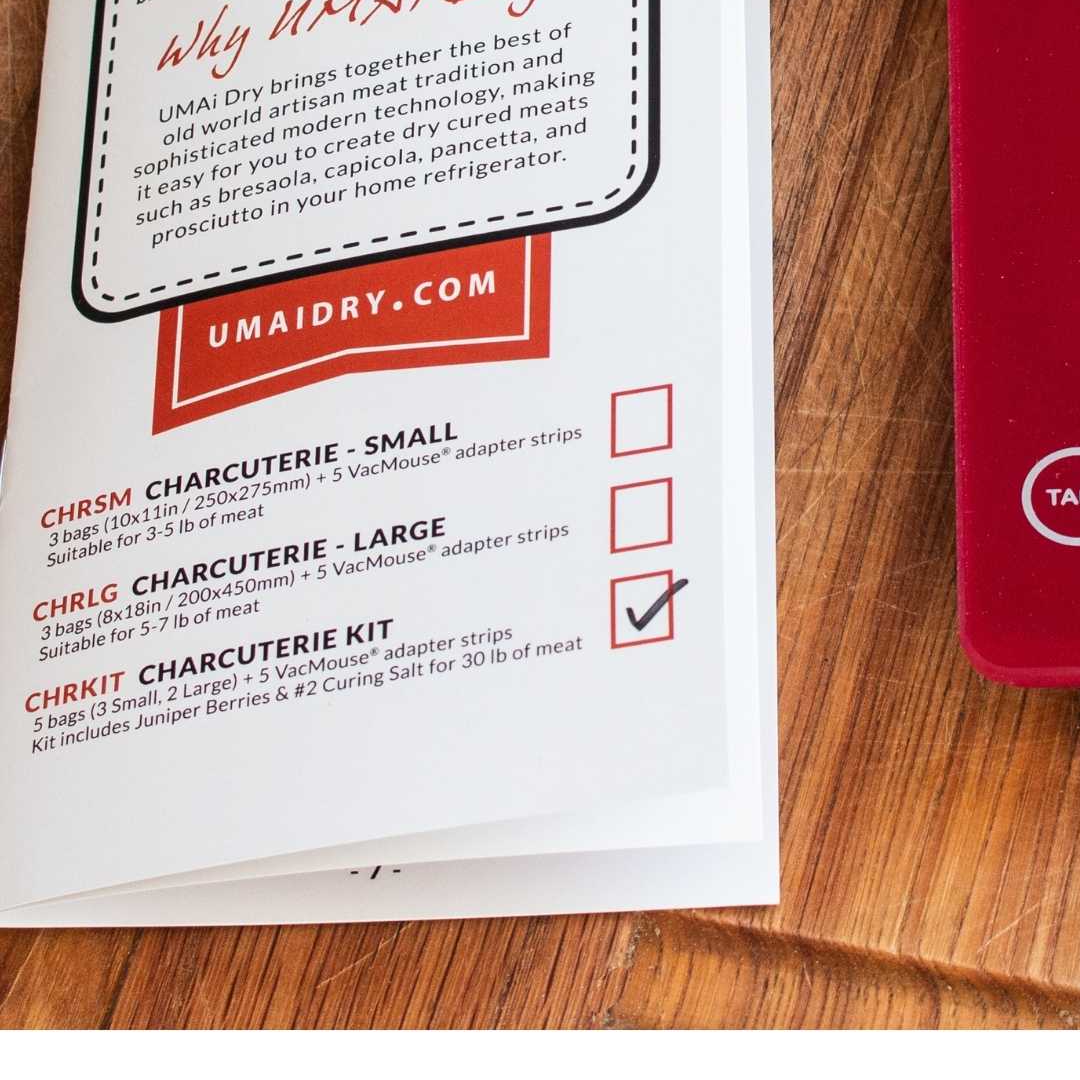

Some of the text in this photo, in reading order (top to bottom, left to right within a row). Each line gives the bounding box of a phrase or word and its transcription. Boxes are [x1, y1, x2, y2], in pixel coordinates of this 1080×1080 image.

[156, 3, 251, 80] Why
[159, 22, 572, 124] UMAi Dry brings together the best of
[132, 71, 596, 179] sophisticated modern technology, making
[137, 95, 589, 202] it easy for you to create dry cured meats
[162, 47, 563, 146] old world artisan meat tradition and
[135, 116, 587, 226] such as bresaola, capicola, pancetta, and
[151, 149, 567, 249] prosciutto in your home refrigerator.
[208, 270, 497, 348] UMAIDRY.COM
[40, 487, 132, 529] CHRSM
[145, 442, 339, 501] CHARCUTERIE
[363, 421, 459, 456] SMALL
[48, 531, 59, 548] 3
[62, 523, 100, 544] bags
[103, 502, 178, 535] (10x11in
[193, 472, 311, 511] 250x275mm)
[332, 466, 343, 483] 5
[455, 437, 526, 460] adapter
[530, 427, 583, 447] strips
[32, 583, 118, 622] CHRLG
[131, 538, 328, 597] CHARCUTERIE
[353, 516, 446, 553] LARGE
[40, 624, 52, 641] 3
[54, 617, 93, 638] bags
[96, 599, 162, 629] (8x18in
[177, 569, 295, 608] 200x450mm)
[316, 563, 327, 580] 5
[440, 534, 513, 558] adapter
[517, 524, 569, 545] strips
[46, 503, 265, 568] Suitable for 3-5 lb of meat
[24, 618, 394, 714] CHRKIT CHARCUTERIE KIT
[33, 716, 44, 733] 5
[47, 709, 86, 730] bags
[90, 700, 108, 721] (3
[111, 688, 163, 714] Small,
[166, 685, 178, 702] 2
[183, 672, 238, 699] Large)
[258, 667, 270, 684] 5
[383, 637, 456, 662] adapter
[460, 627, 513, 648] strips
[38, 599, 261, 662] Suitable for 5-7 lb of meat
[31, 735, 57, 754] Kit
[60, 720, 131, 747] includes
[134, 705, 202, 730] Juniper
[205, 691, 271, 716] Berries
[293, 679, 318, 698] #2
[322, 671, 385, 693] Curing
[389, 661, 424, 682] Salt
[428, 658, 457, 675] for
[461, 650, 486, 669] 30
[490, 647, 508, 665] lb
[511, 642, 531, 661] of
[536, 636, 582, 657] meat
